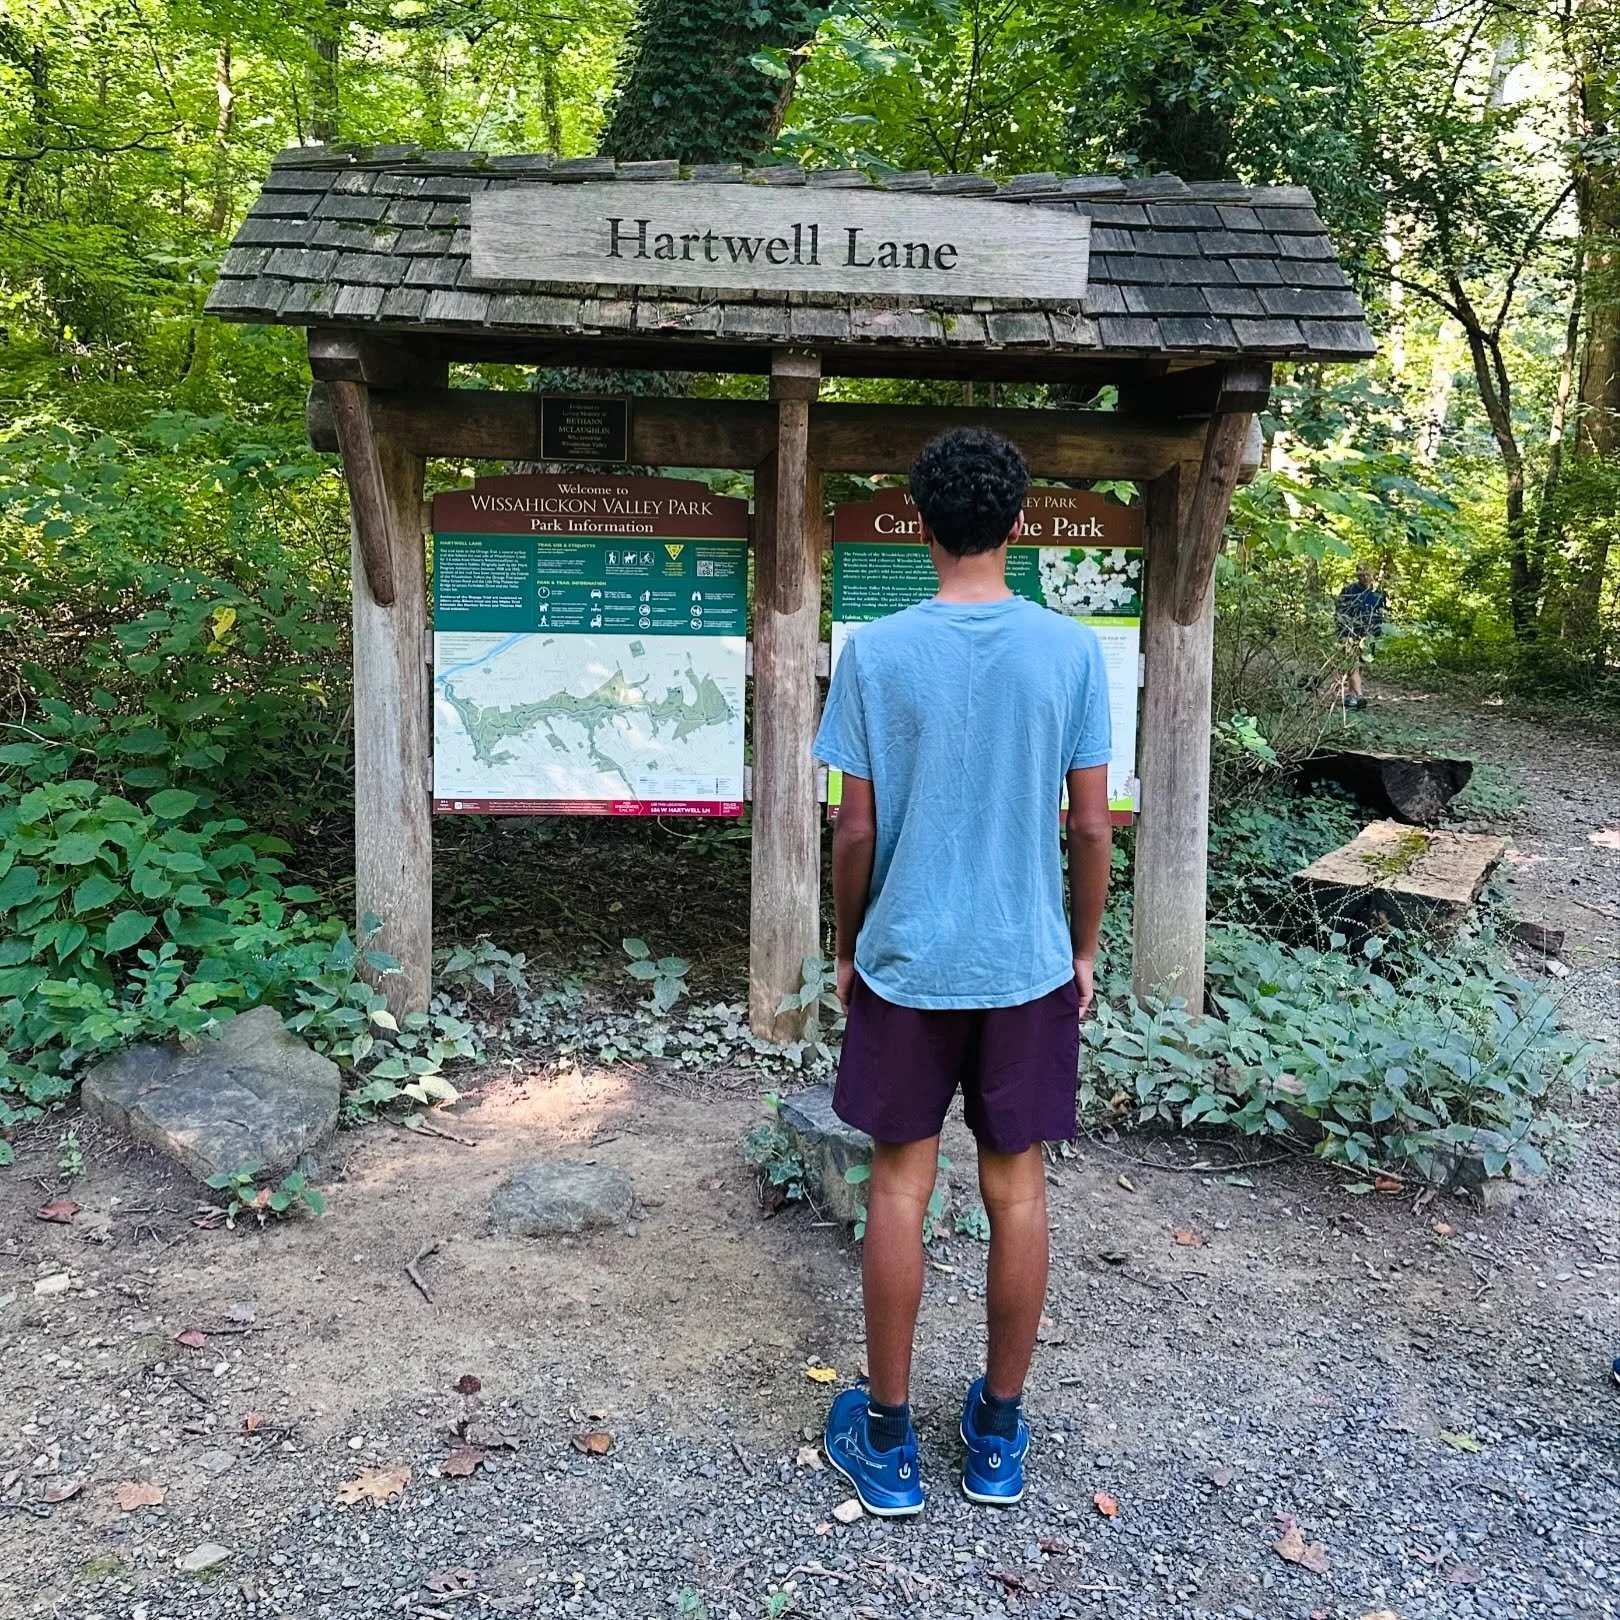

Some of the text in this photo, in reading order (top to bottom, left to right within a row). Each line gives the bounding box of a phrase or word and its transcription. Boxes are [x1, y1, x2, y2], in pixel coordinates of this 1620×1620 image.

[606, 218, 959, 271] Hartwell Lane
[566, 417, 602, 425] BETHANN
[558, 426, 610, 434] MCLAUGHLIN
[557, 483, 629, 496] Welcome to
[470, 495, 713, 516] WISSAHICKON VALLEY PARK
[1044, 496, 1078, 509] PARK
[530, 519, 654, 534] Park Information
[1052, 517, 1105, 538] Park
